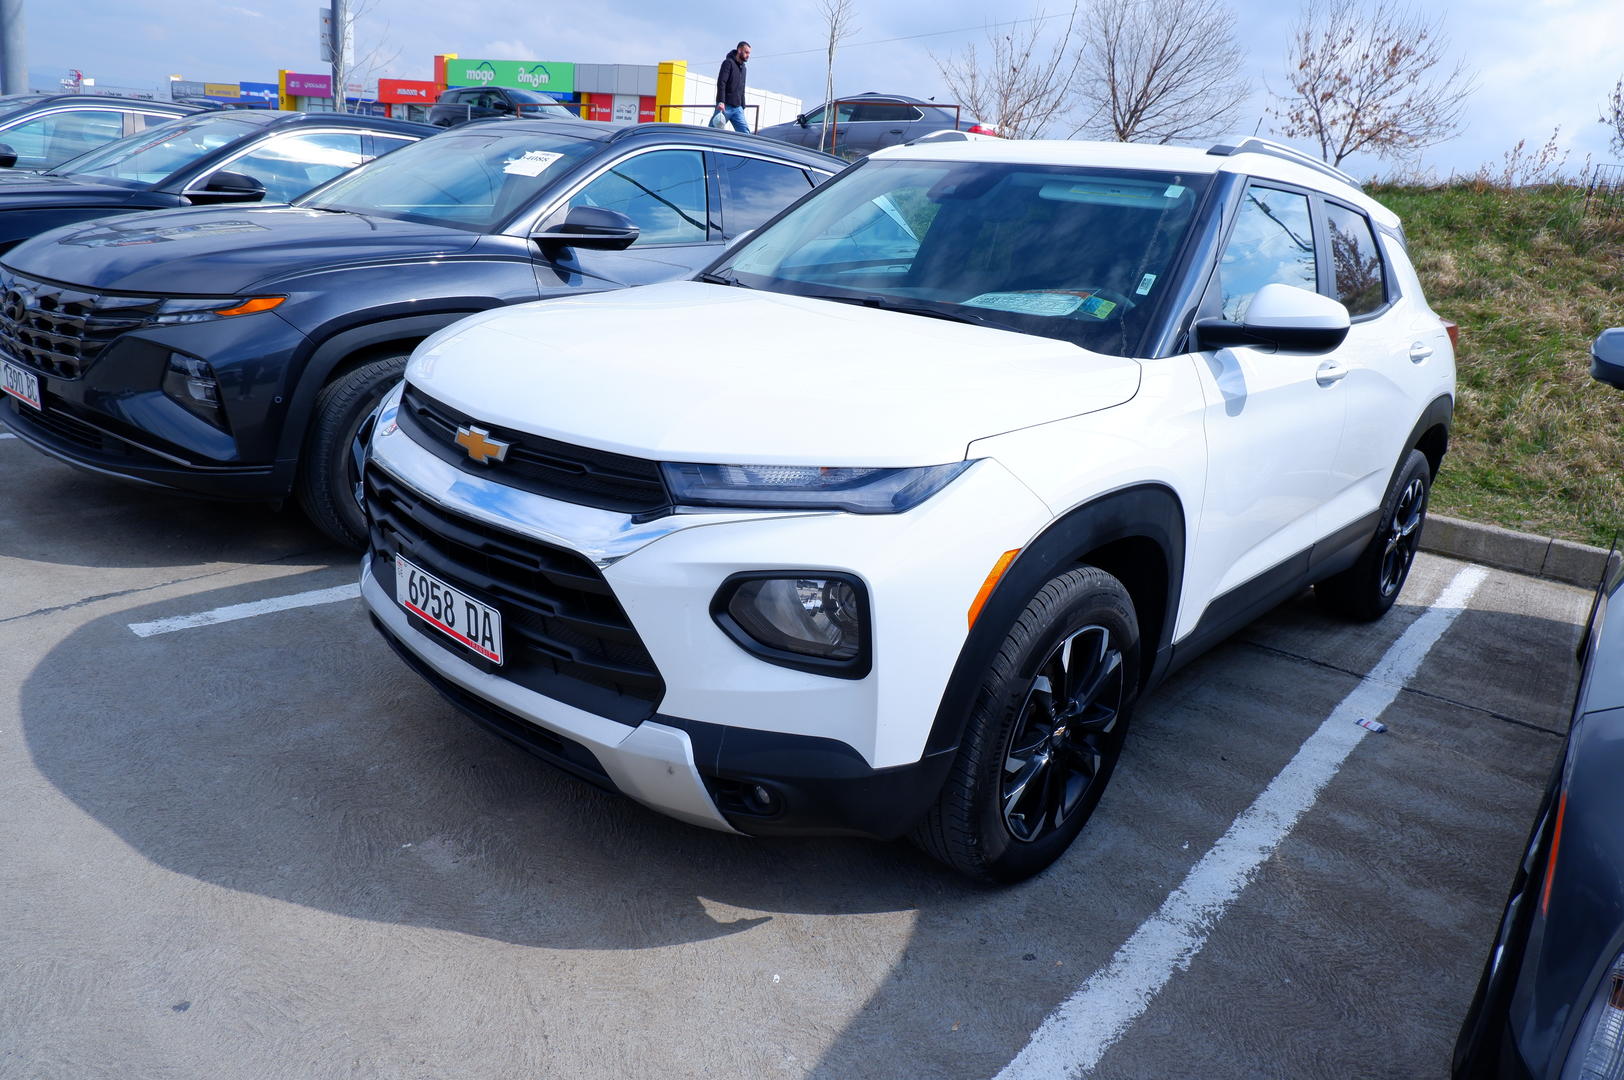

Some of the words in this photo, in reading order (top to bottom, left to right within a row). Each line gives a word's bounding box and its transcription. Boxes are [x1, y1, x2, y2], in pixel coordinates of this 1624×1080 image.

[466, 70, 494, 86] mogo
[518, 67, 549, 87] მოგო
[409, 570, 455, 628] 6958
[465, 600, 495, 652] DA
